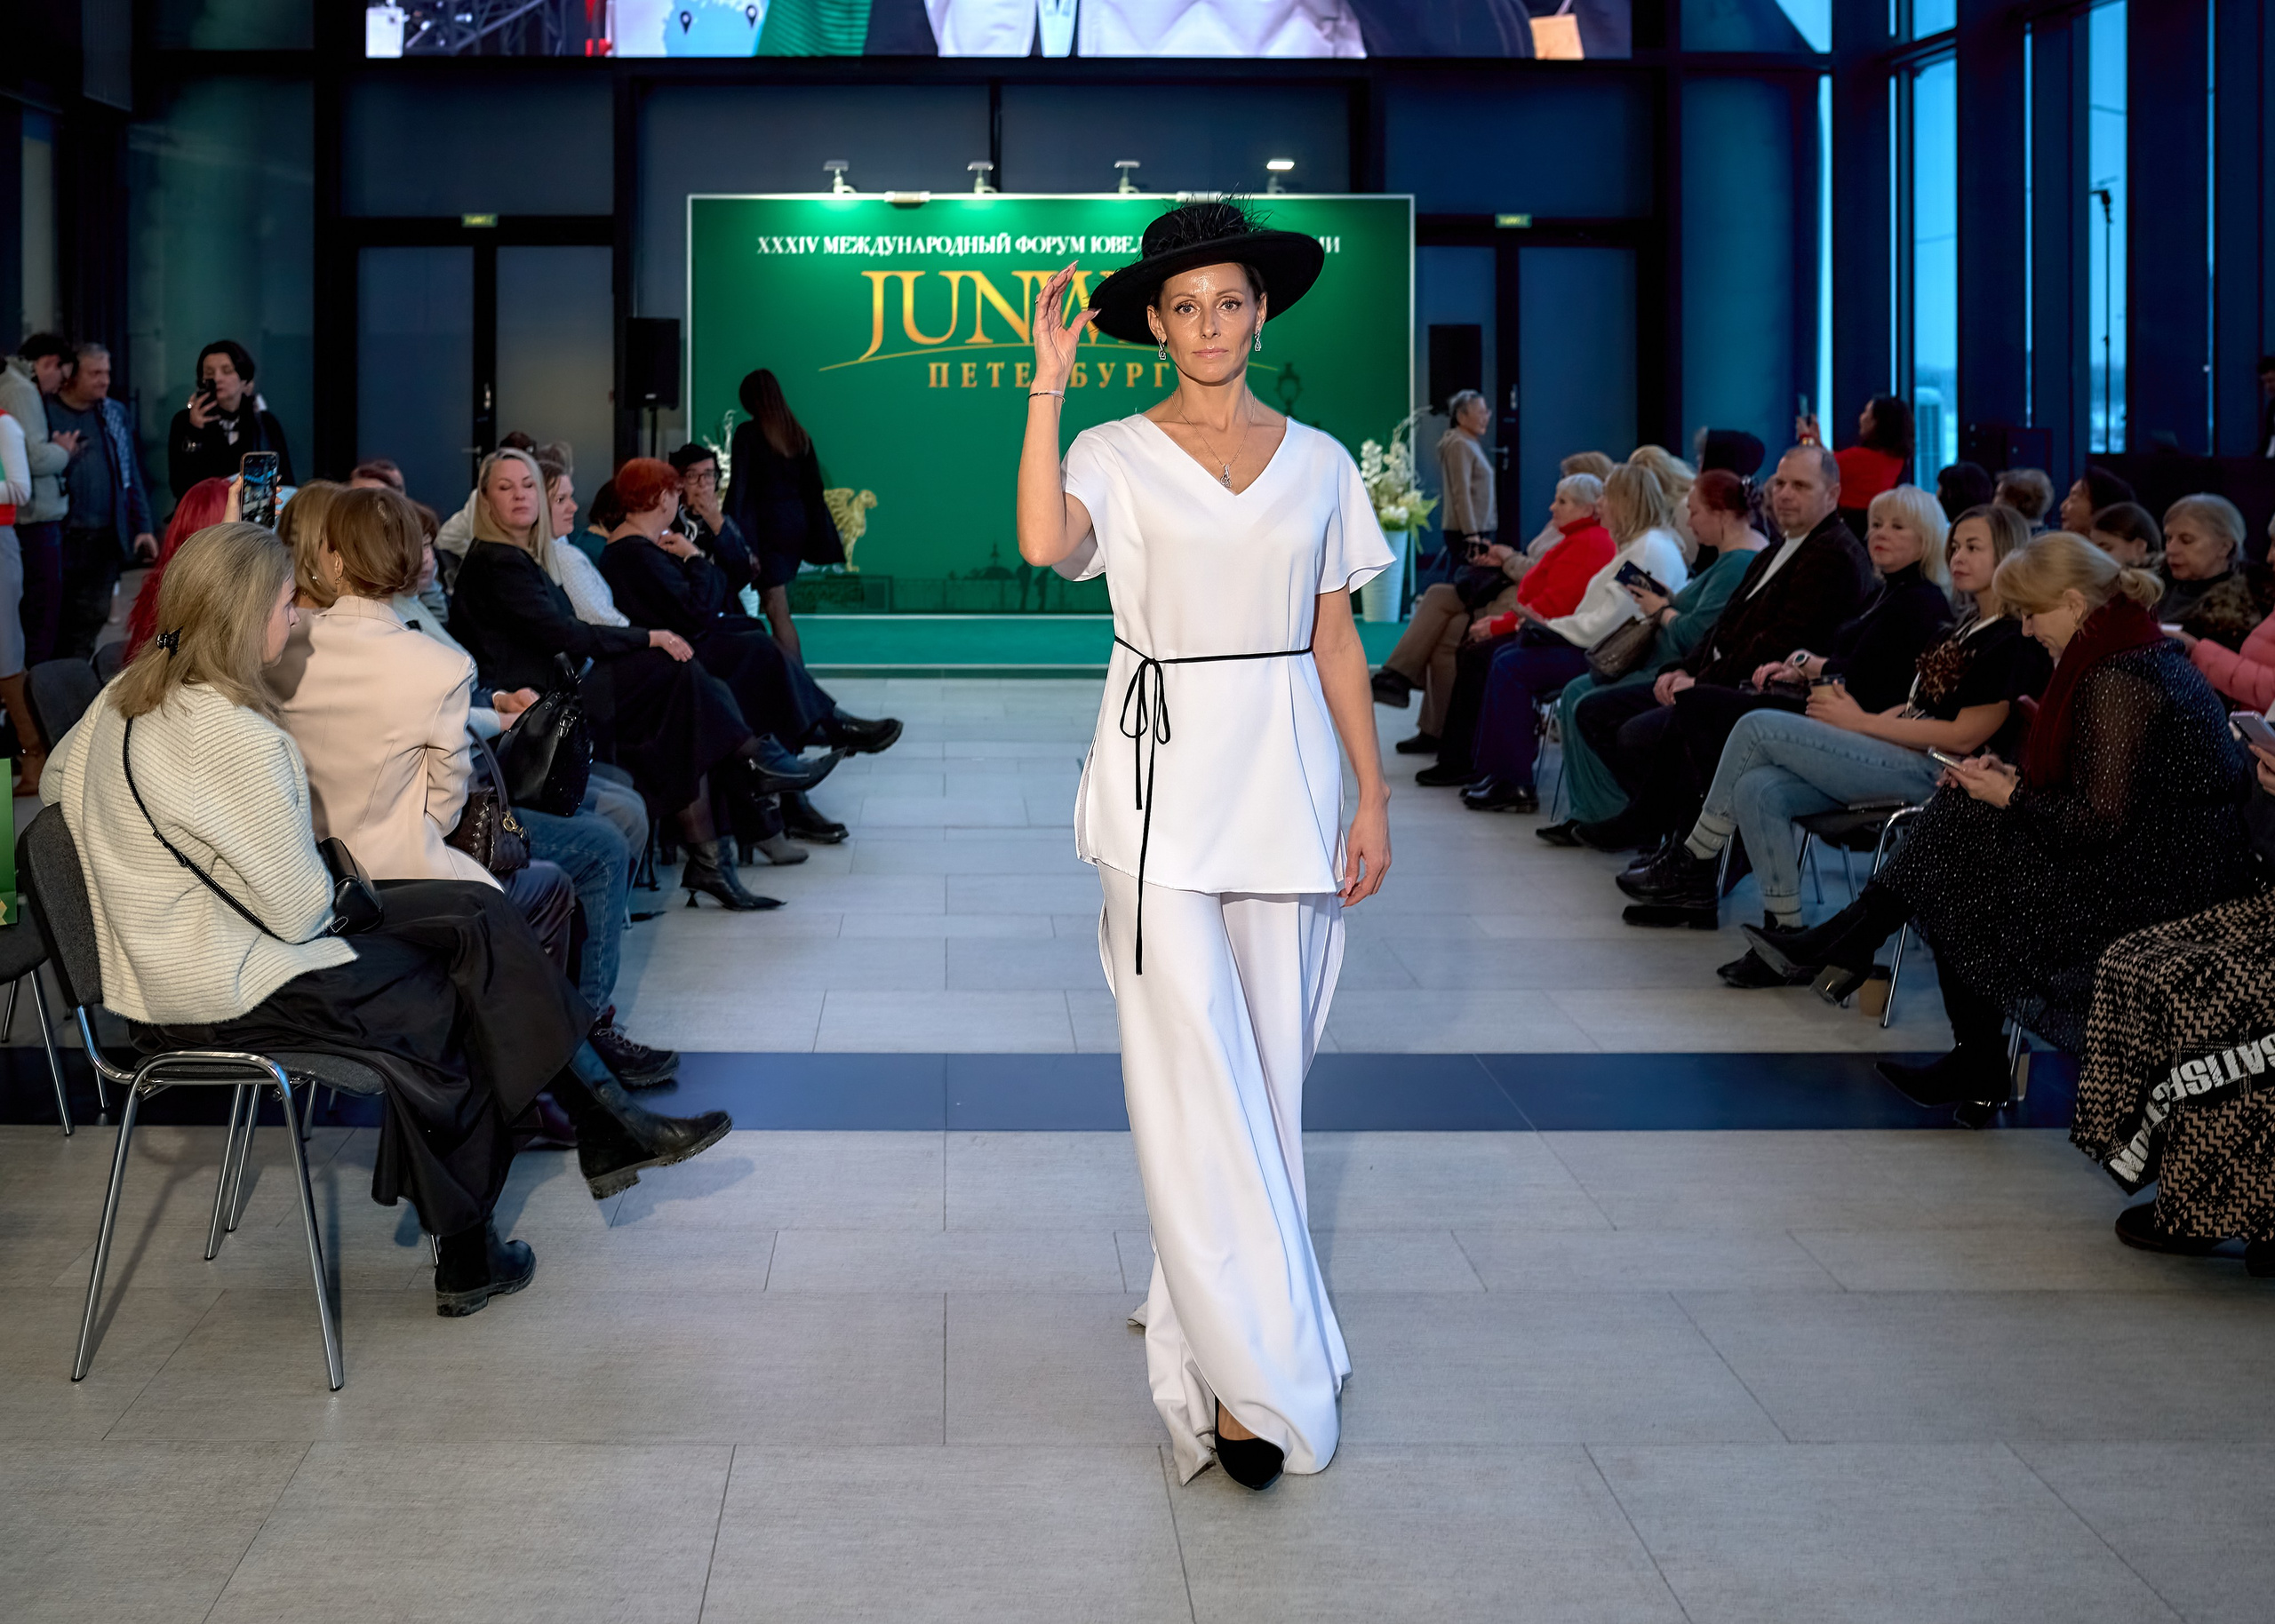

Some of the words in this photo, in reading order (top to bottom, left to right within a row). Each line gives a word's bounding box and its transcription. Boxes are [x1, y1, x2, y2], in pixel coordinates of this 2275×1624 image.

[756, 235, 819, 254] XXXIV
[823, 232, 1011, 256] МЕЖДУНАРОДНЫЙ
[1015, 235, 1085, 256] ФОРУМ
[928, 362, 1170, 388] ПЕТЕБУРГ
